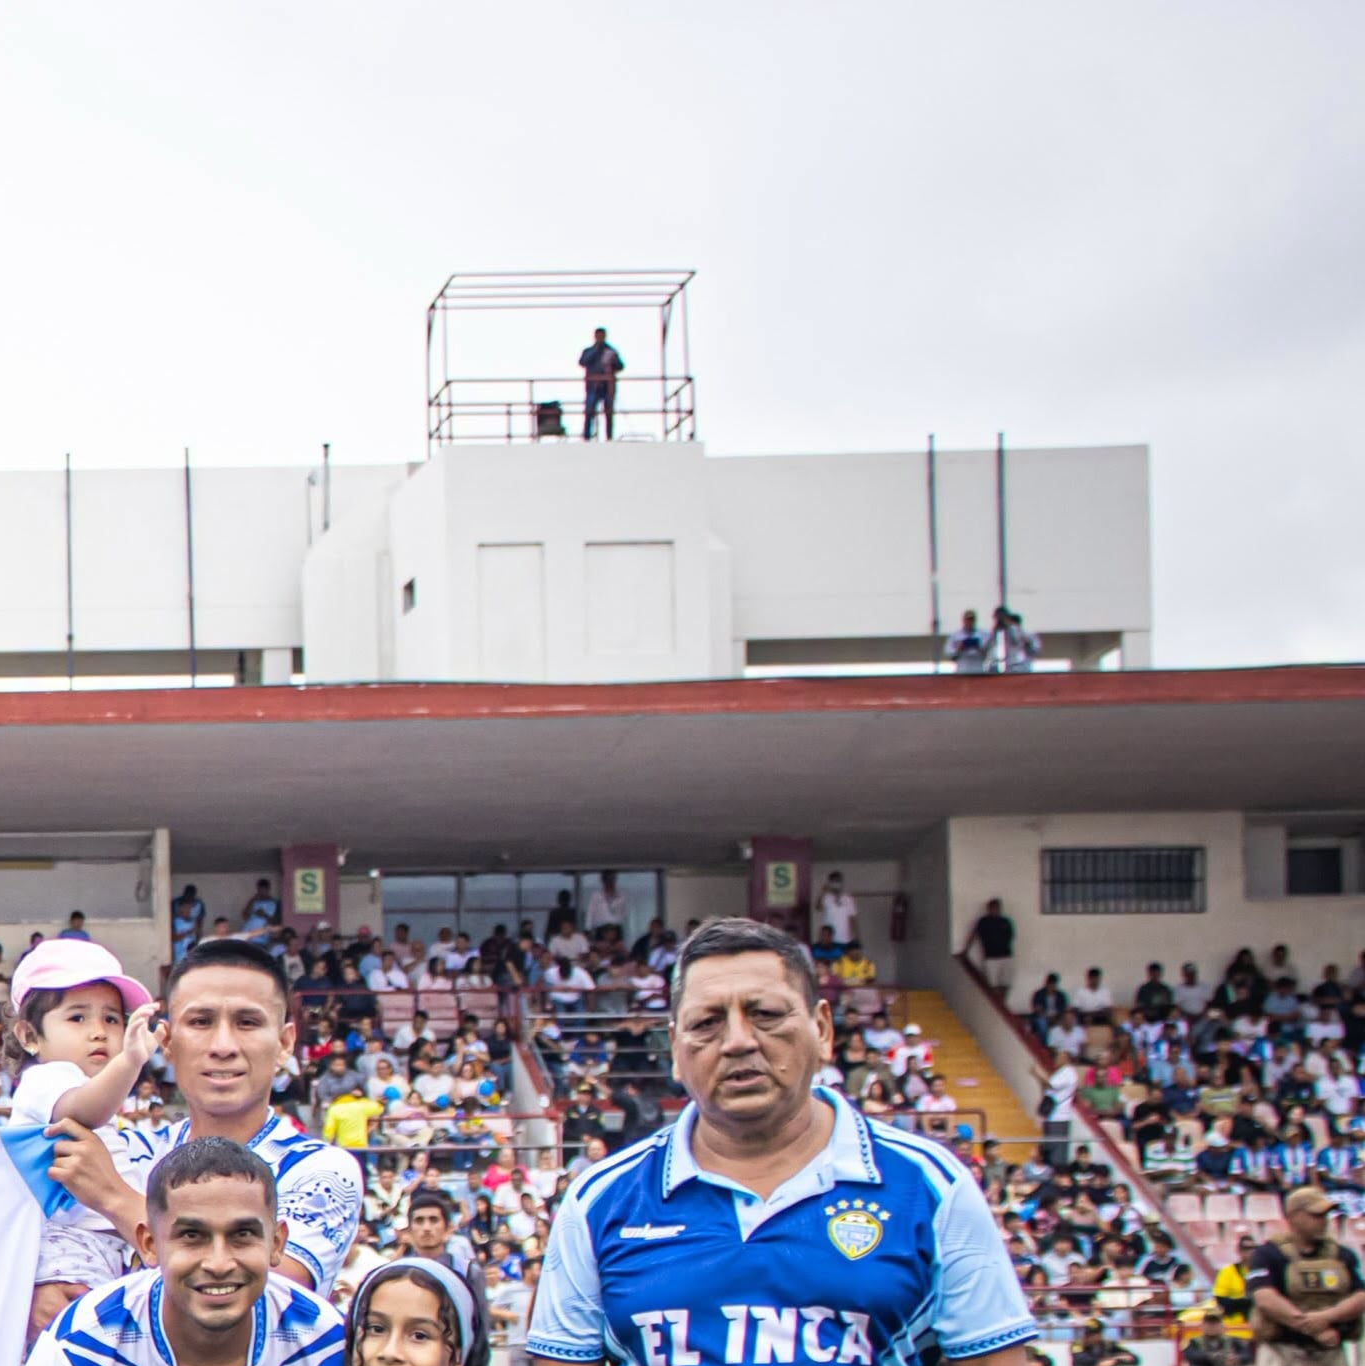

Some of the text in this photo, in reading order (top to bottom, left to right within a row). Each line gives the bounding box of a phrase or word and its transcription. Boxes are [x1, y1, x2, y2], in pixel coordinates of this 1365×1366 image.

[300, 872, 318, 895] S
[773, 865, 791, 888] S
[721, 1305, 874, 1366] INCA
